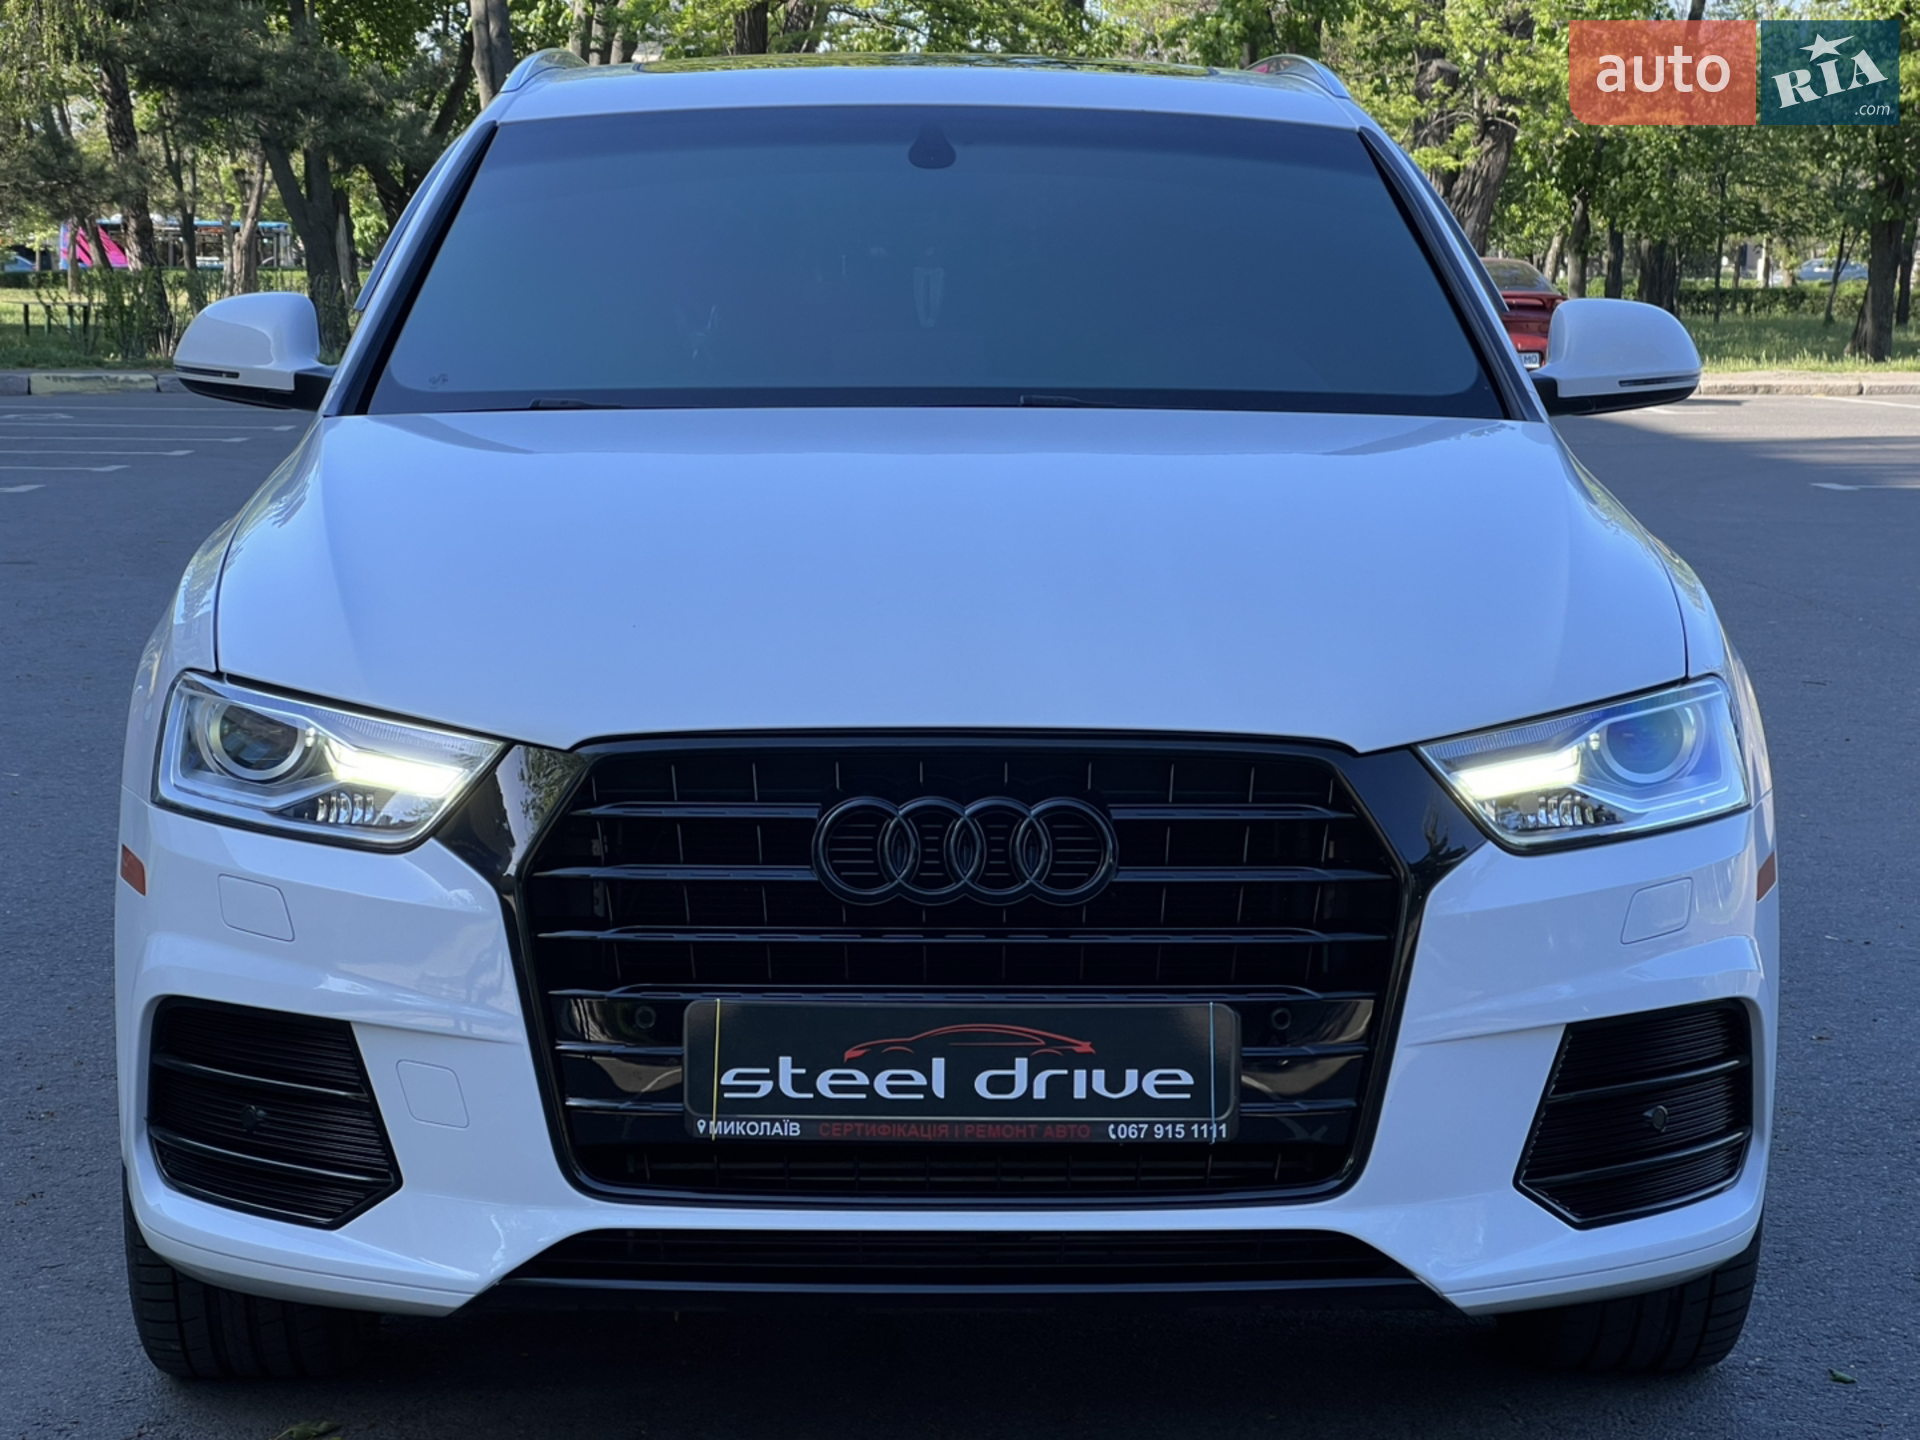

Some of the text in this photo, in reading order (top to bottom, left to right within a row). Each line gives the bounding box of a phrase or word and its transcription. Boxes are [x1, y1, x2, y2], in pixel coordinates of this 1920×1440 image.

[720, 1056, 1195, 1100] steel drive
[709, 1119, 801, 1137] МИКОЛАЇВ
[818, 1122, 949, 1140] СЕРТИФІКАЦІЯ
[964, 1124, 1039, 1139] РЕМОНТ
[1043, 1124, 1091, 1139] АВТО
[1117, 1123, 1227, 1139] 067 915 1111
